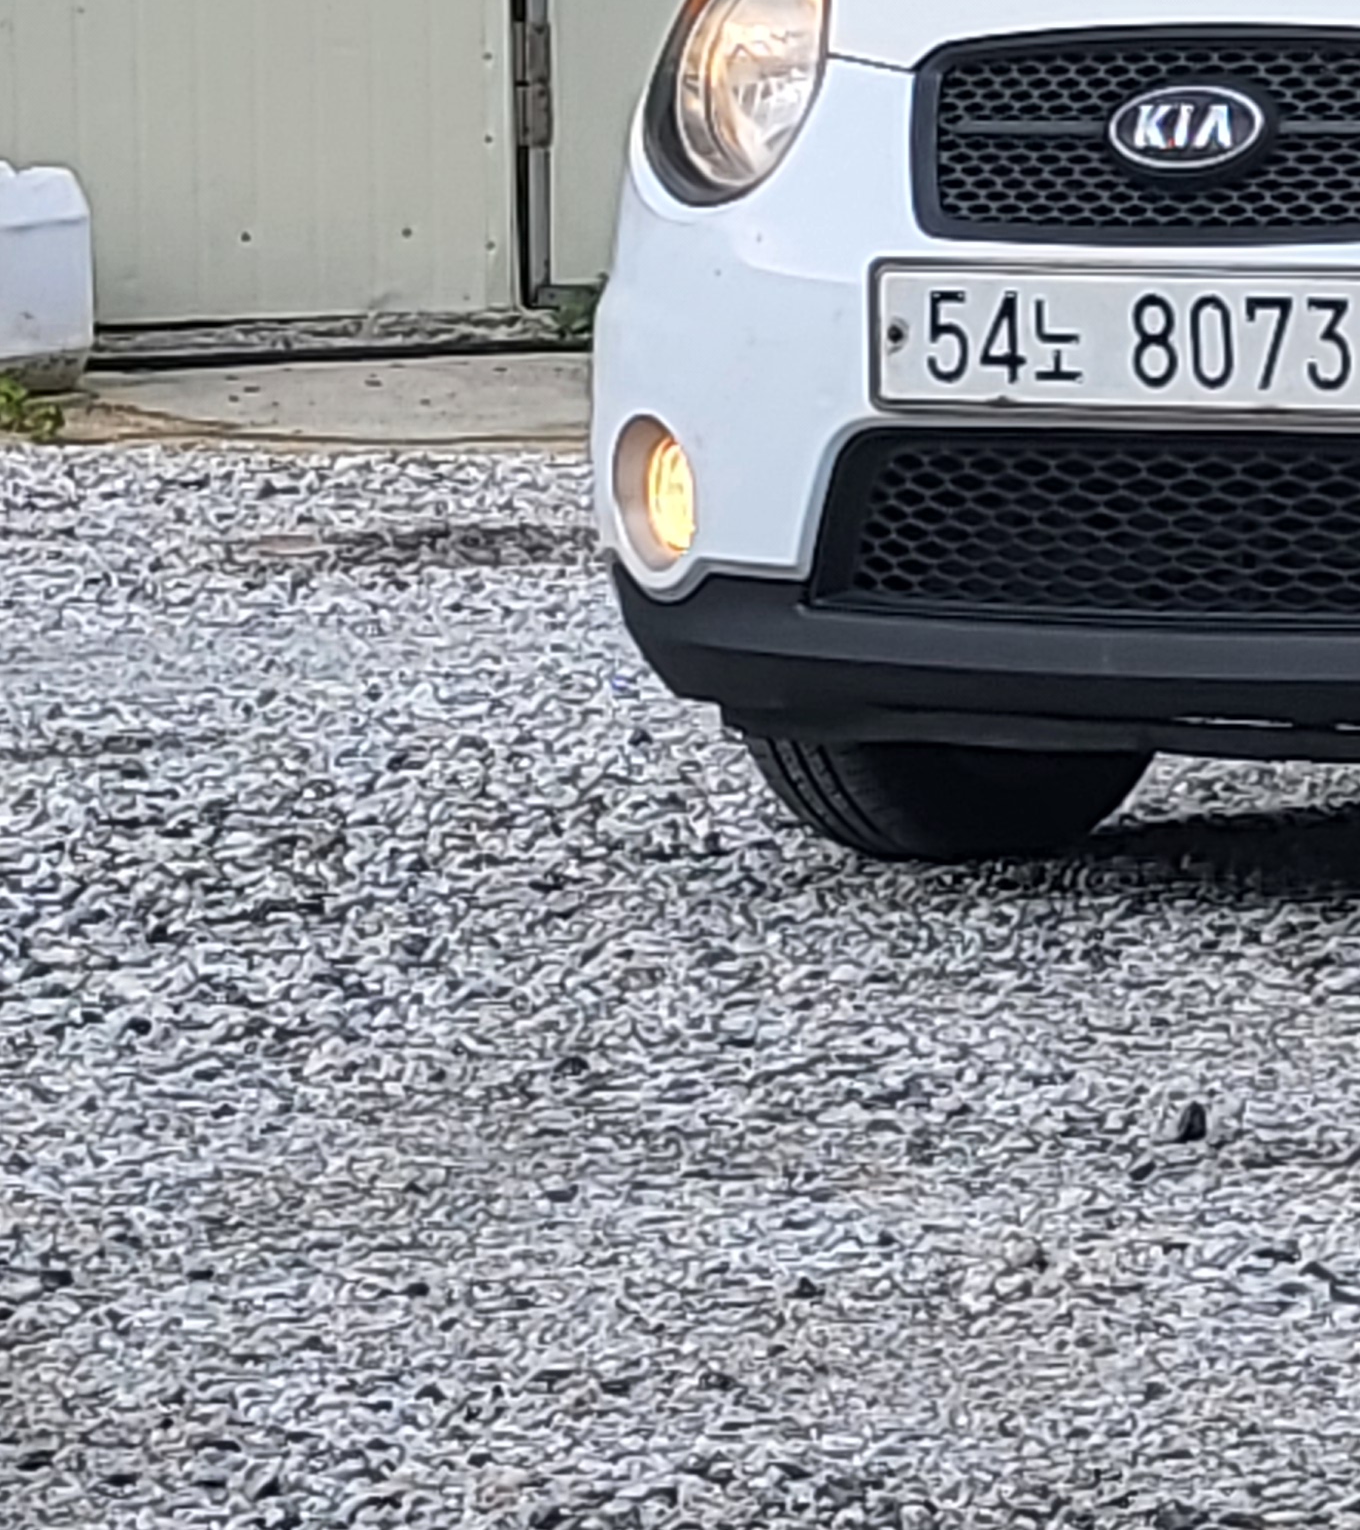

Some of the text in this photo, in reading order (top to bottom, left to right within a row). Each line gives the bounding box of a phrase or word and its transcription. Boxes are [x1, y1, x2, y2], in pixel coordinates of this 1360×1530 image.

[1133, 103, 1233, 150] KIA
[926, 290, 1352, 390] 54노 8073
